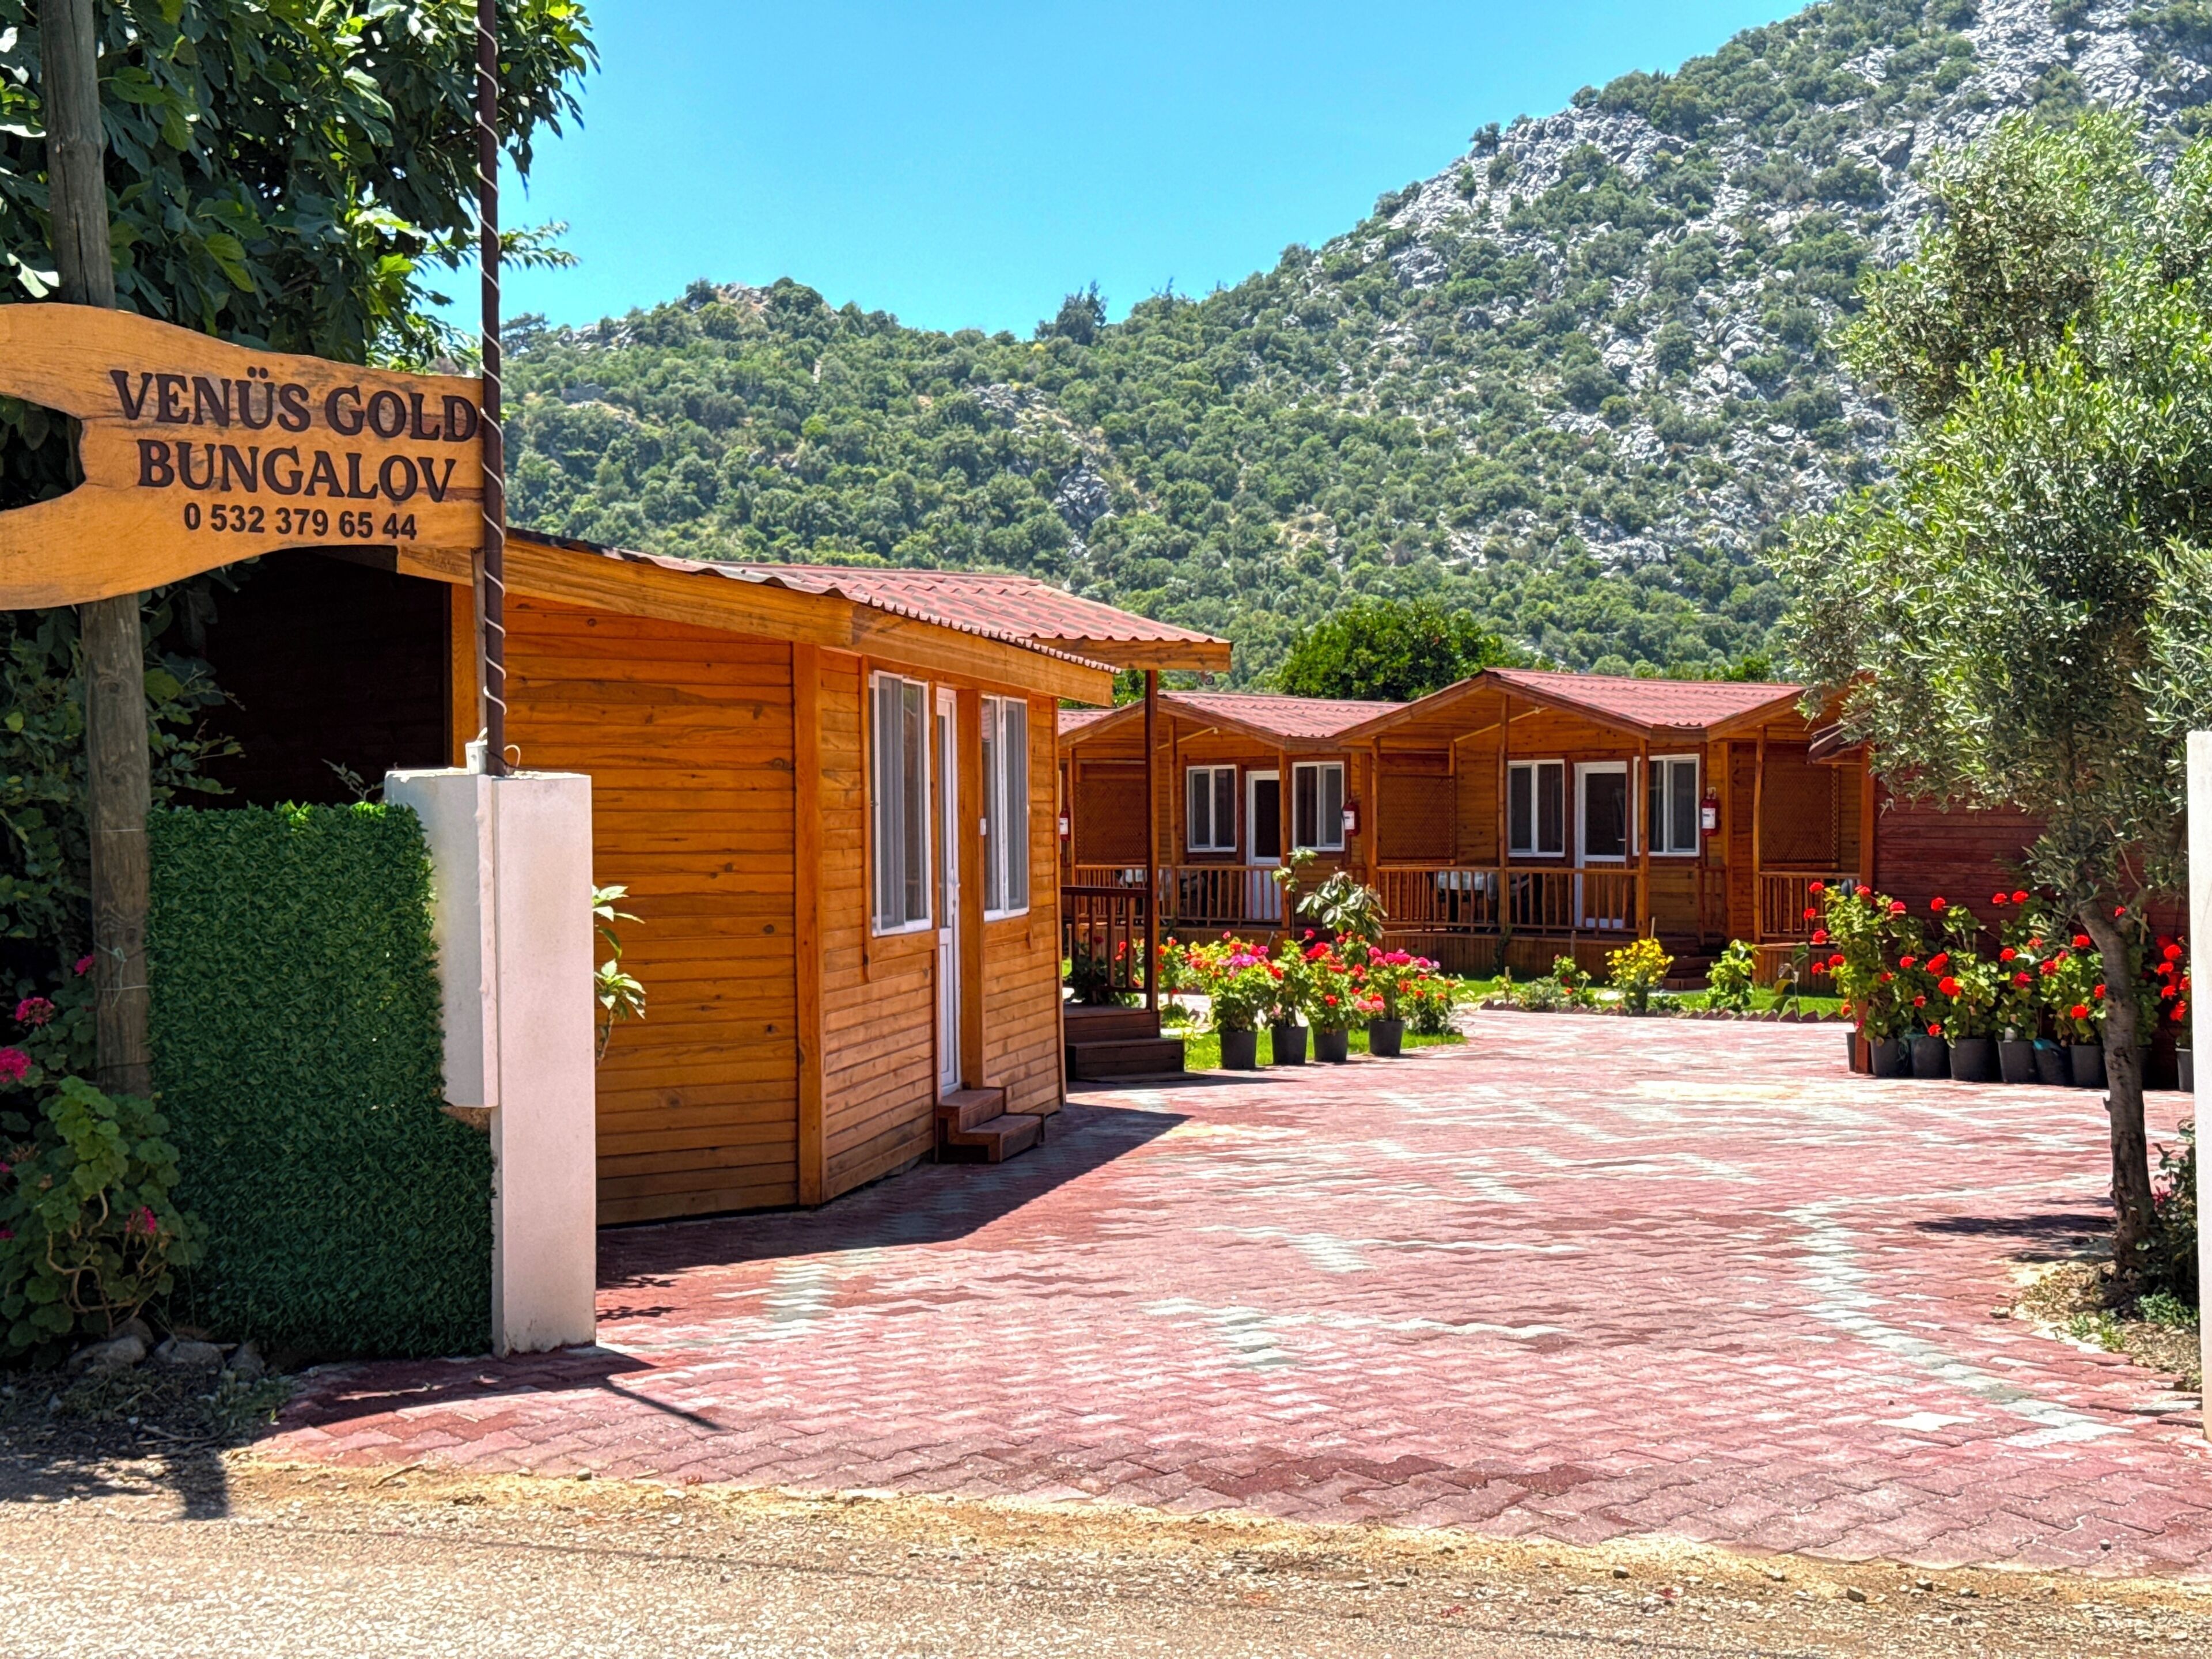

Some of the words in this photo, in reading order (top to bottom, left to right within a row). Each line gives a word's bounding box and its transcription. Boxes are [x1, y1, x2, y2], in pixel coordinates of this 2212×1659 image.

[110, 367, 312, 432] VENÜS
[325, 385, 478, 442] GOLD
[137, 439, 457, 502] BUNGALOV
[184, 502, 201, 530] 0
[210, 505, 265, 533] 532
[276, 507, 328, 536] 379
[339, 511, 373, 538] 65
[382, 513, 417, 540] 44
